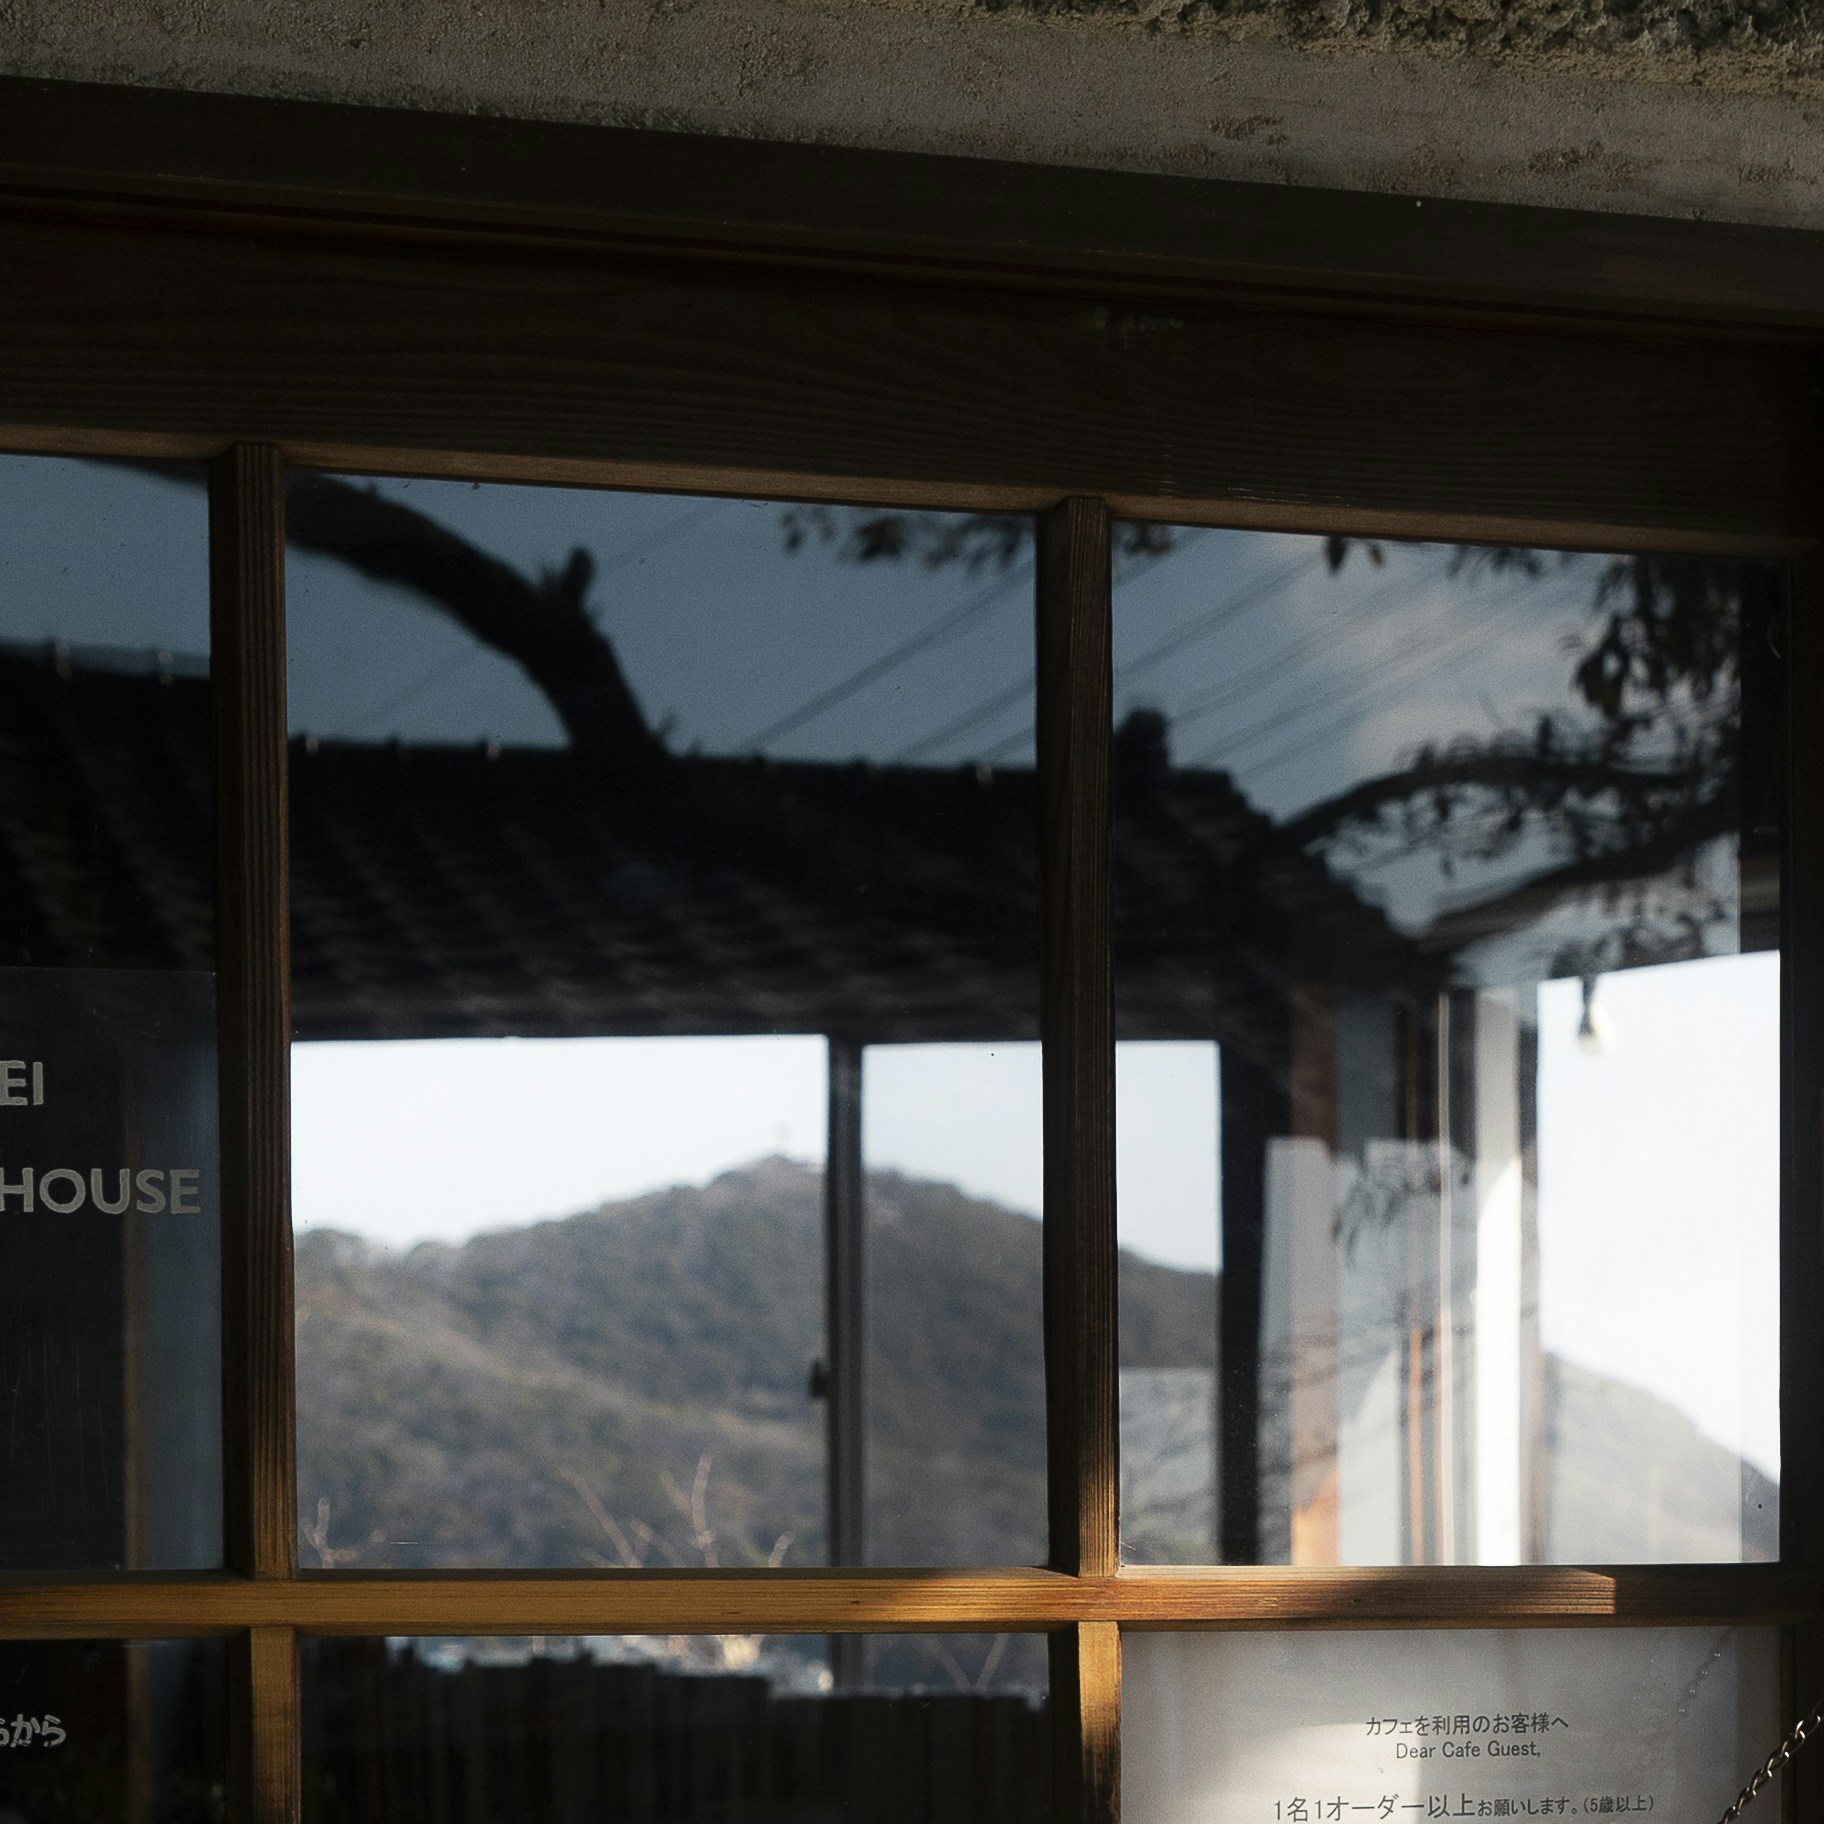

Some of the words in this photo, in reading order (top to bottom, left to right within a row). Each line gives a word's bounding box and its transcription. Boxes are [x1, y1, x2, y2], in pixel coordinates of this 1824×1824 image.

[1365, 1712, 1569, 1737] カフェを利用のお客様へ
[1396, 1743, 1436, 1759] Dear
[1442, 1742, 1481, 1758] Cafe
[1488, 1740, 1541, 1759] Guest,
